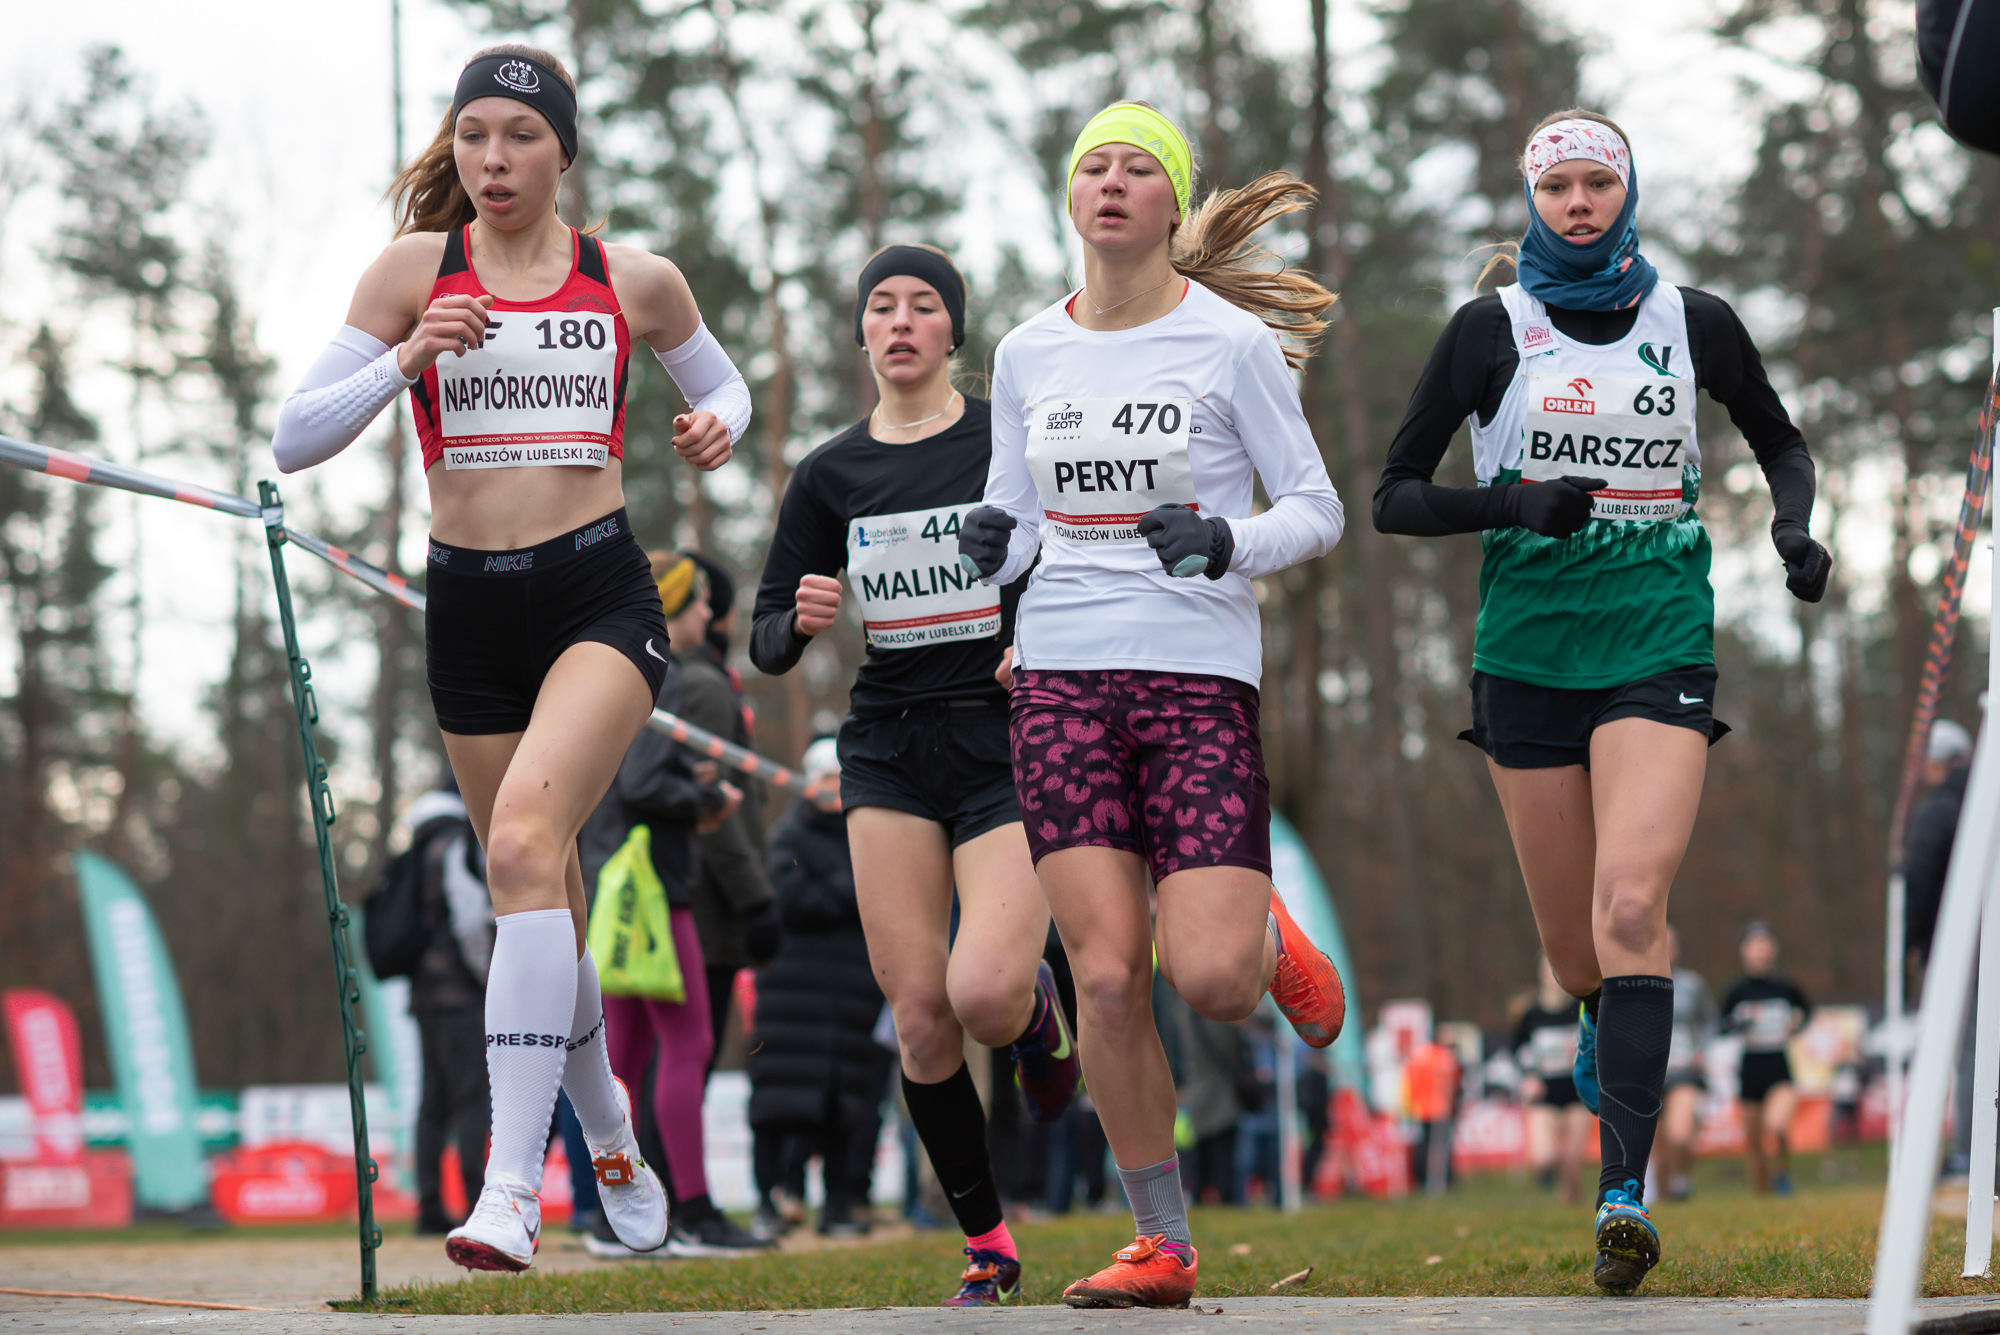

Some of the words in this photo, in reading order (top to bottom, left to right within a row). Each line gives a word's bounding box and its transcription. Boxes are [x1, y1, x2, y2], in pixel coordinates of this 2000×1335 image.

[535, 318, 606, 350] 180
[1523, 328, 1550, 344] Anwil
[444, 368, 609, 412] NAPIÓRKOWSKA
[1633, 385, 1676, 417] 63
[1546, 398, 1593, 414] ORLEN
[1111, 403, 1181, 435] 470
[451, 447, 522, 464] TOMASZÓW
[527, 448, 582, 461] LUBELSKI
[586, 448, 605, 462] 2021
[1530, 430, 1683, 469] BARSZCZ
[1054, 459, 1158, 493] PERYT
[1601, 503, 1650, 515] LUBELSKI
[1652, 504, 1674, 515] 2021
[575, 517, 619, 550] NIKE
[868, 526, 908, 538] lubelskie
[920, 511, 960, 544] 44
[1054, 525, 1110, 541] TOMASZÓW
[484, 552, 534, 572] NIKE
[872, 630, 926, 644] TOMASZÓW
[929, 624, 975, 639] LUBELSKI
[978, 619, 999, 633] 2021
[486, 1033, 570, 1048] PRESSP
